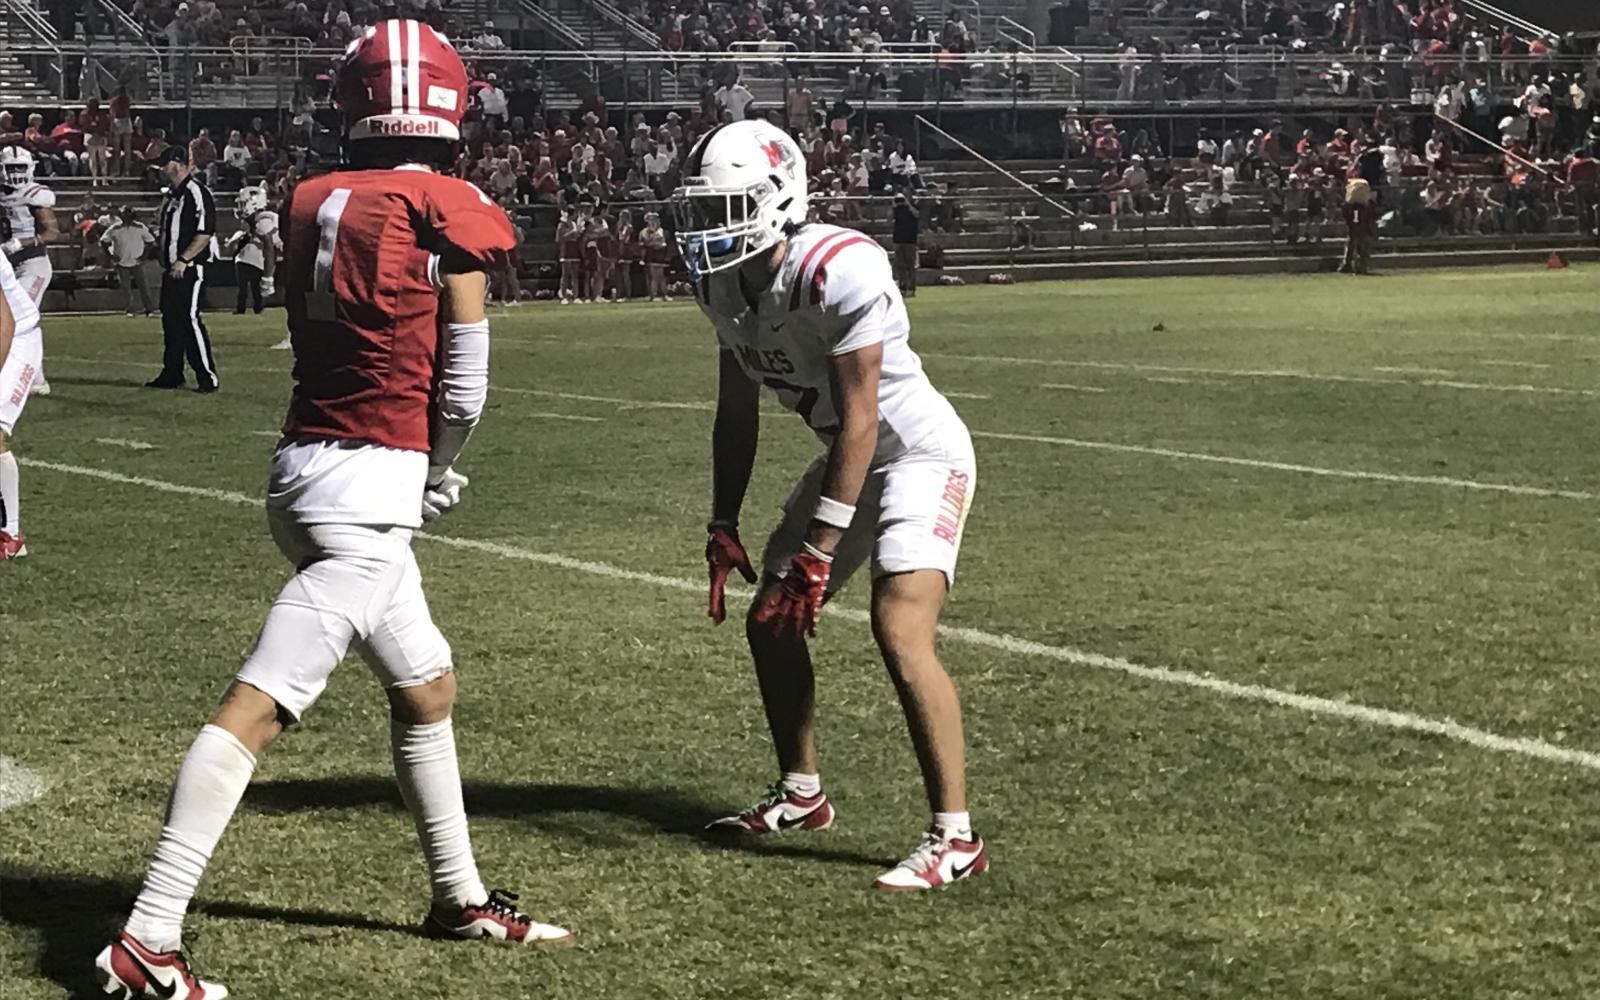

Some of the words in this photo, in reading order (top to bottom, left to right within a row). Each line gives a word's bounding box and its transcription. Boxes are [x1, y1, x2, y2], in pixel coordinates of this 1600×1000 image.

[366, 86, 374, 101] 1
[369, 119, 439, 135] Riddell
[303, 188, 353, 323] 1
[932, 469, 969, 547] BULLDOGS
